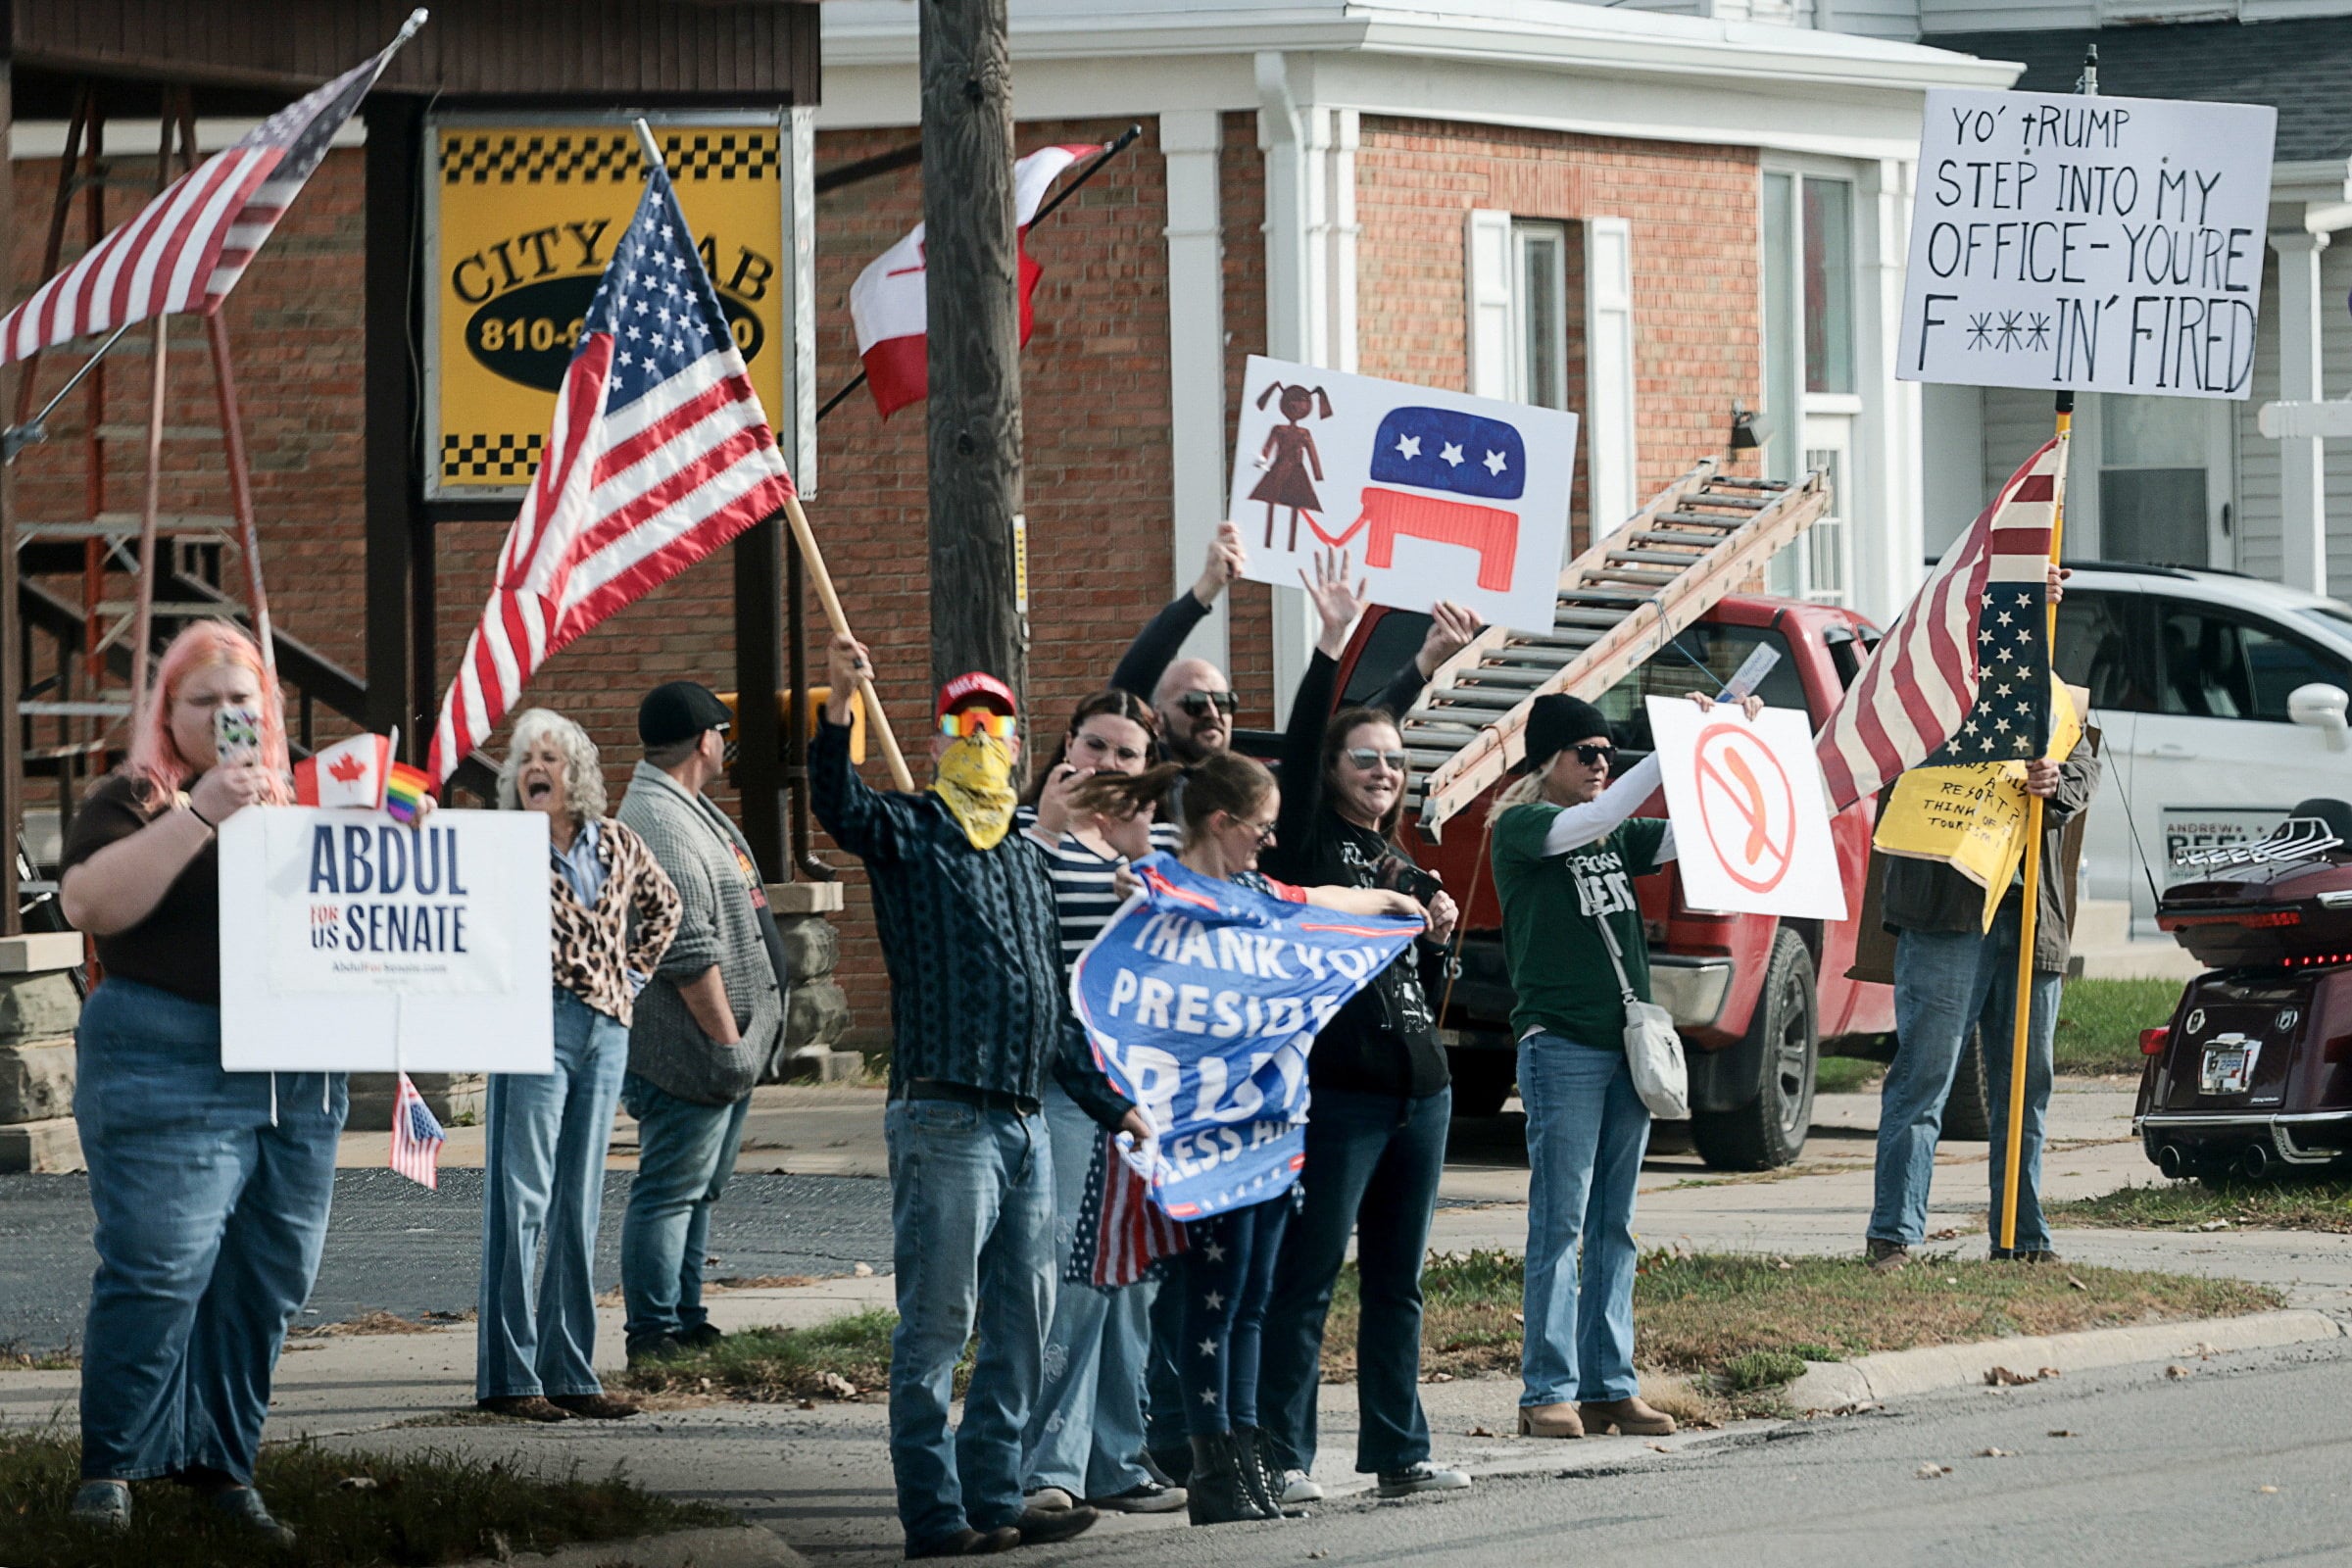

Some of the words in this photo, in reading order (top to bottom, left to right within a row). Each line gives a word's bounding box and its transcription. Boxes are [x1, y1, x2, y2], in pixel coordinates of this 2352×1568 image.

[1951, 106, 2006, 146] YO'
[1936, 159, 2037, 211] STEP
[2056, 164, 2138, 217] INTO
[2157, 169, 2222, 224] MY
[452, 218, 612, 305] CITY
[696, 234, 774, 302] AB
[2129, 296, 2257, 393] FIRED
[1985, 777, 1996, 790] A
[1923, 799, 1977, 818] THINK
[309, 824, 468, 896] ABDUL
[310, 906, 339, 924] FOR
[311, 925, 339, 950] US
[346, 905, 468, 954] SENATE
